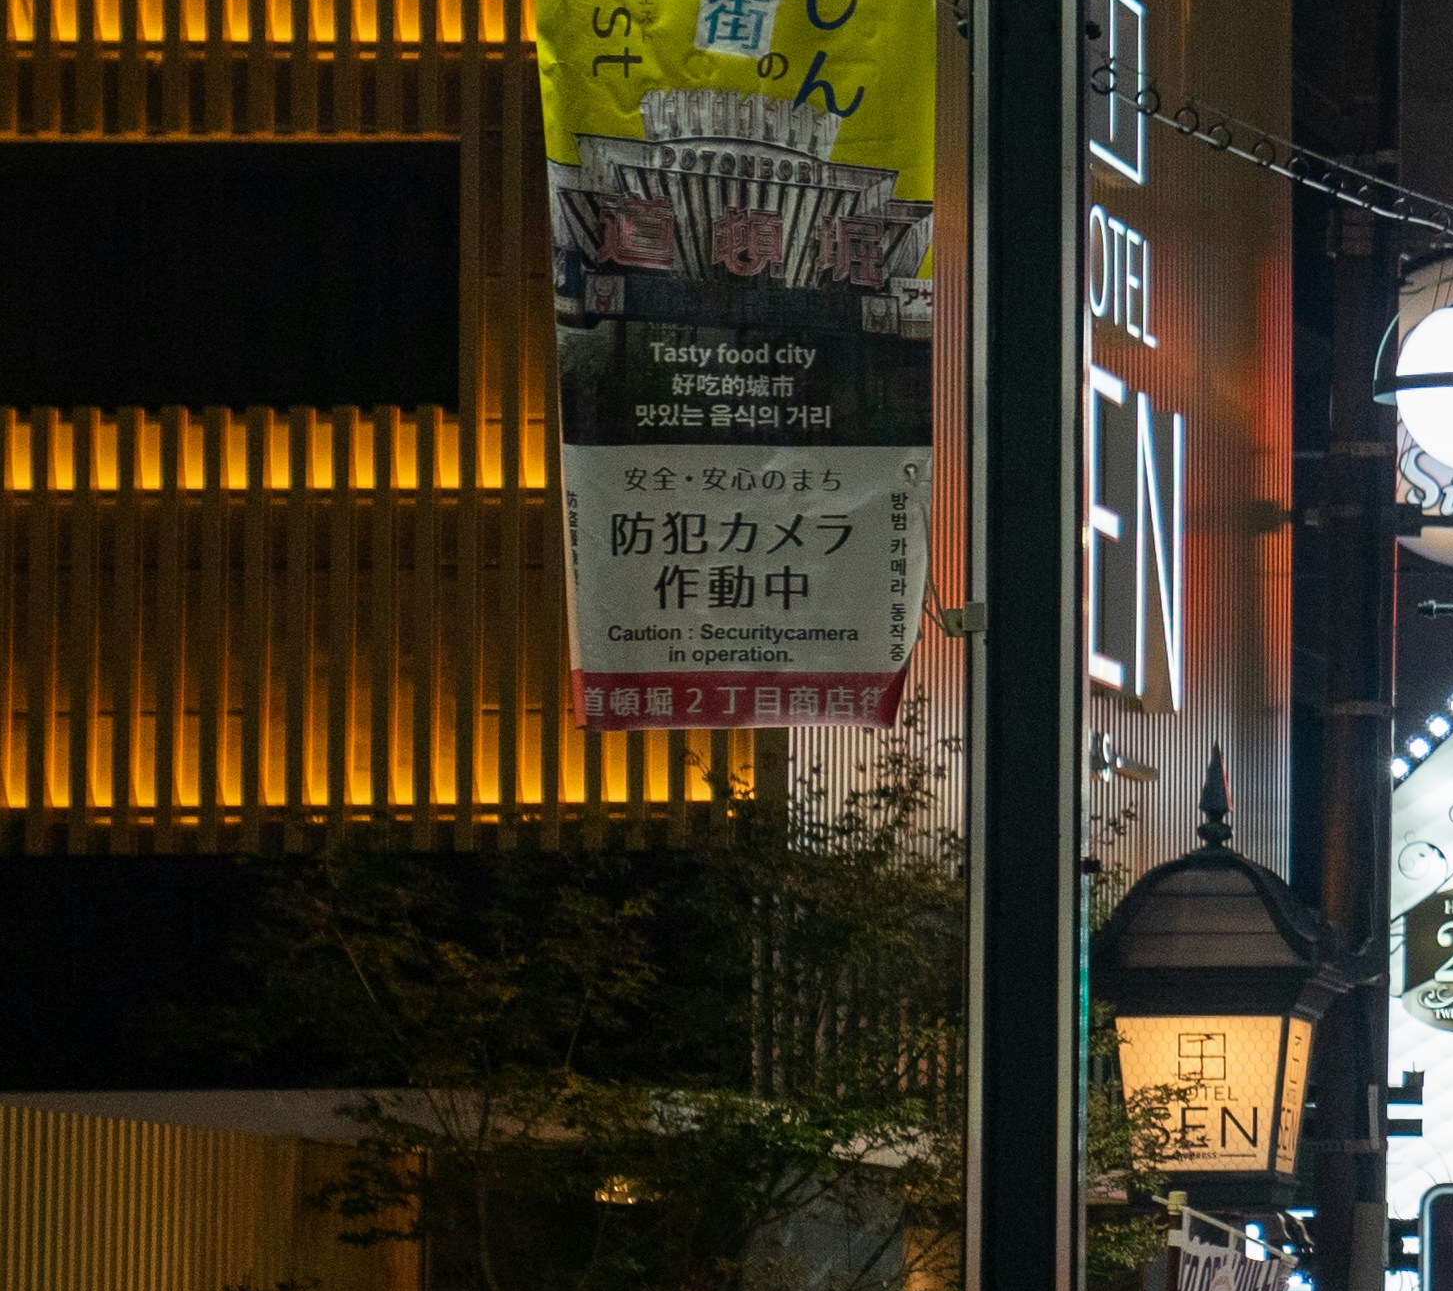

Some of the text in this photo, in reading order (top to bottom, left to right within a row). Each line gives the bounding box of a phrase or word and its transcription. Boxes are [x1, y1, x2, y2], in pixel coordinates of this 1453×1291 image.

[757, 52, 790, 81] の
[1089, 204, 1158, 350] OTEL
[650, 341, 817, 368] Tasty food city
[671, 374, 795, 398] 好吃的城市
[635, 404, 832, 429] 맛있는 음식의 거리
[624, 467, 842, 492] 安全・安心のまち
[611, 511, 854, 556] 防犯カメラ
[653, 565, 810, 610] 作動中
[607, 625, 682, 643] Caution
[668, 647, 795, 665] in operation.
